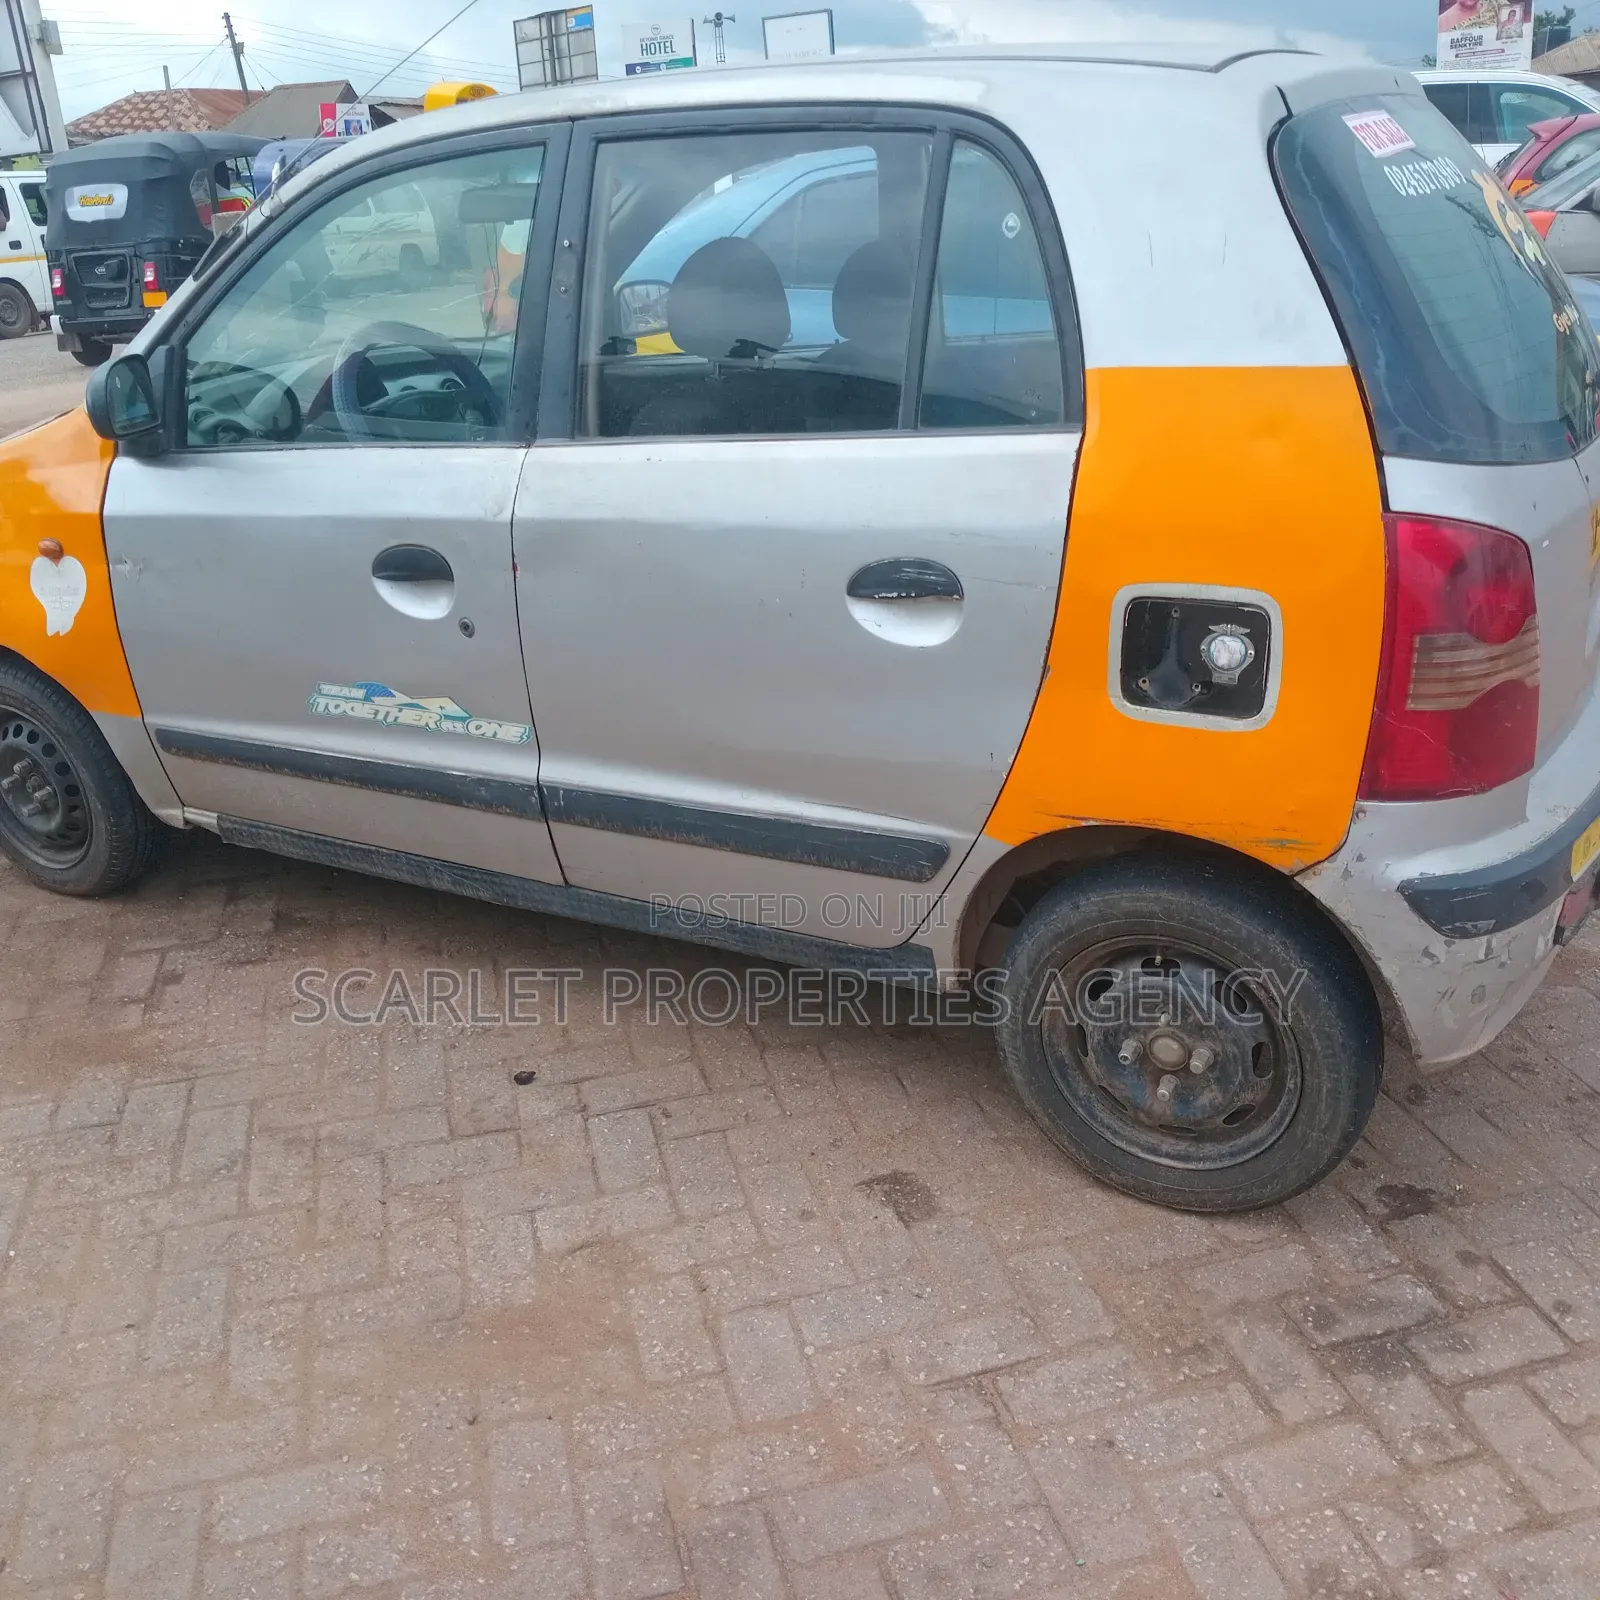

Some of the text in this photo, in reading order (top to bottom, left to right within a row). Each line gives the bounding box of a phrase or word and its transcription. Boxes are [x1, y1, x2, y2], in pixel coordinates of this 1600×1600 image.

[640, 40, 676, 57] HOTEL
[1450, 35, 1484, 45] BAFFOUR
[1352, 118, 1411, 152] FOR SALE
[310, 697, 441, 731] TOGETHER
[466, 719, 530, 743] ONE
